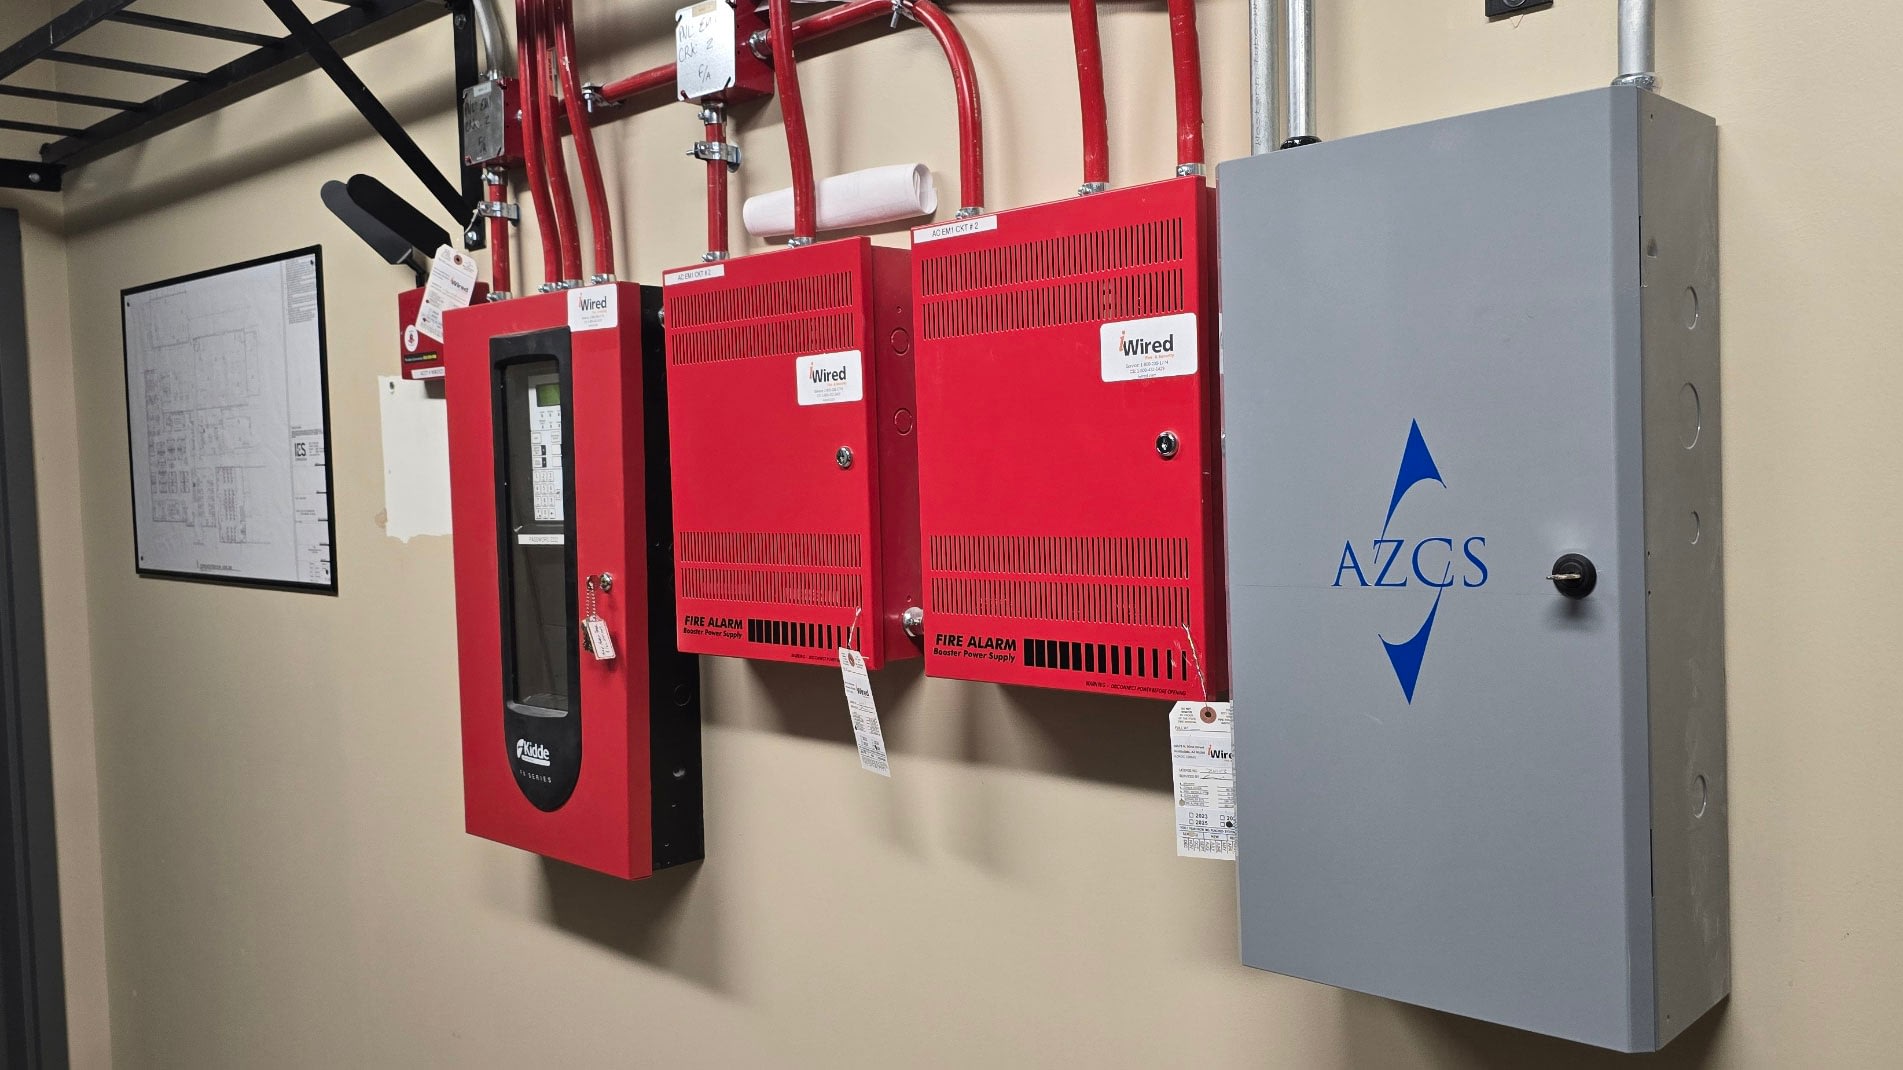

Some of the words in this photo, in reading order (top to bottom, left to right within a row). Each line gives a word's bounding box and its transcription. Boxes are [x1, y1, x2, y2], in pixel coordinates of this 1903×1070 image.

[932, 229, 941, 238] AC
[955, 224, 969, 233] CKT
[974, 221, 979, 230] 2
[579, 292, 607, 311] iWired
[1119, 330, 1174, 356] iWired
[809, 361, 847, 383] iWired
[1331, 537, 1488, 588] AZCS
[684, 615, 705, 627] FIRE
[708, 617, 743, 630] ALARM
[683, 627, 704, 635] Booster
[704, 629, 722, 637] Power
[722, 630, 743, 639] Supply
[935, 634, 963, 647] FIRE
[967, 636, 1017, 652] ALARM
[933, 647, 961, 657] Booster
[963, 650, 987, 659] Power
[988, 651, 1016, 663] Supply
[523, 740, 550, 760] Kidde
